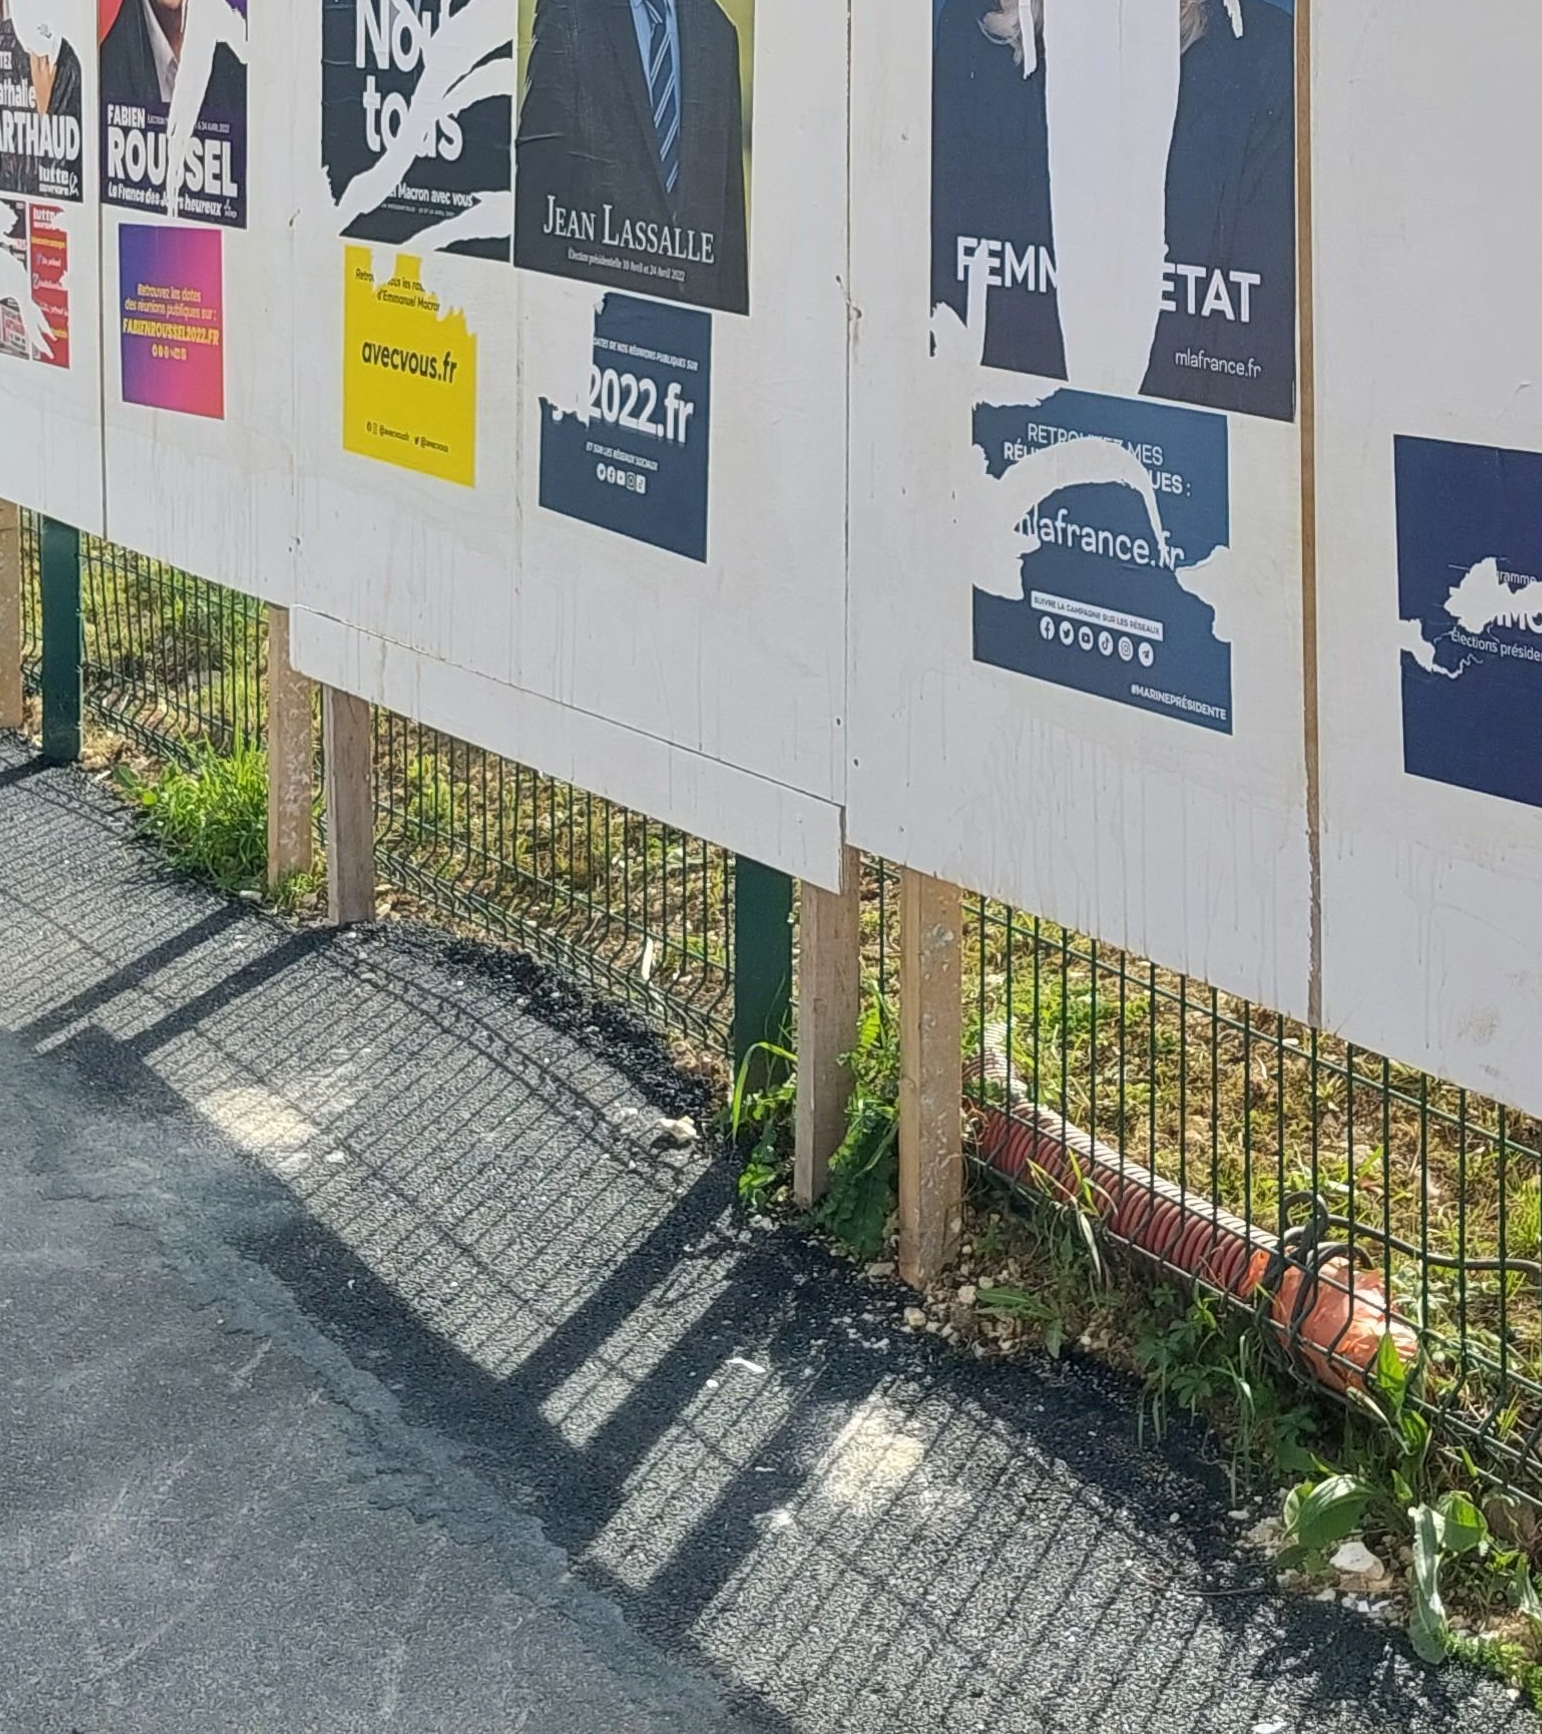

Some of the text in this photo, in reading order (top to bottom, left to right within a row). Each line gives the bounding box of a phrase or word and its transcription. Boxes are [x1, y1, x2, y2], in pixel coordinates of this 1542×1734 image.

[107, 104, 146, 129] FABIEN
[118, 183, 144, 204] France
[145, 188, 160, 206] des
[185, 194, 223, 216] heureux
[398, 181, 429, 202] Macron
[431, 190, 451, 205] avec
[452, 192, 473, 207] vous
[137, 283, 201, 303] Retrouvez les dates
[361, 341, 458, 384] avecvous.fr
[1174, 347, 1262, 379] mlafrance.fr
[1034, 596, 1161, 636] SUIVRE LA CAMPAGNE SUR LES RÉSEAUX
[1130, 683, 1227, 721] #MARINEPRÉSIDENTE
